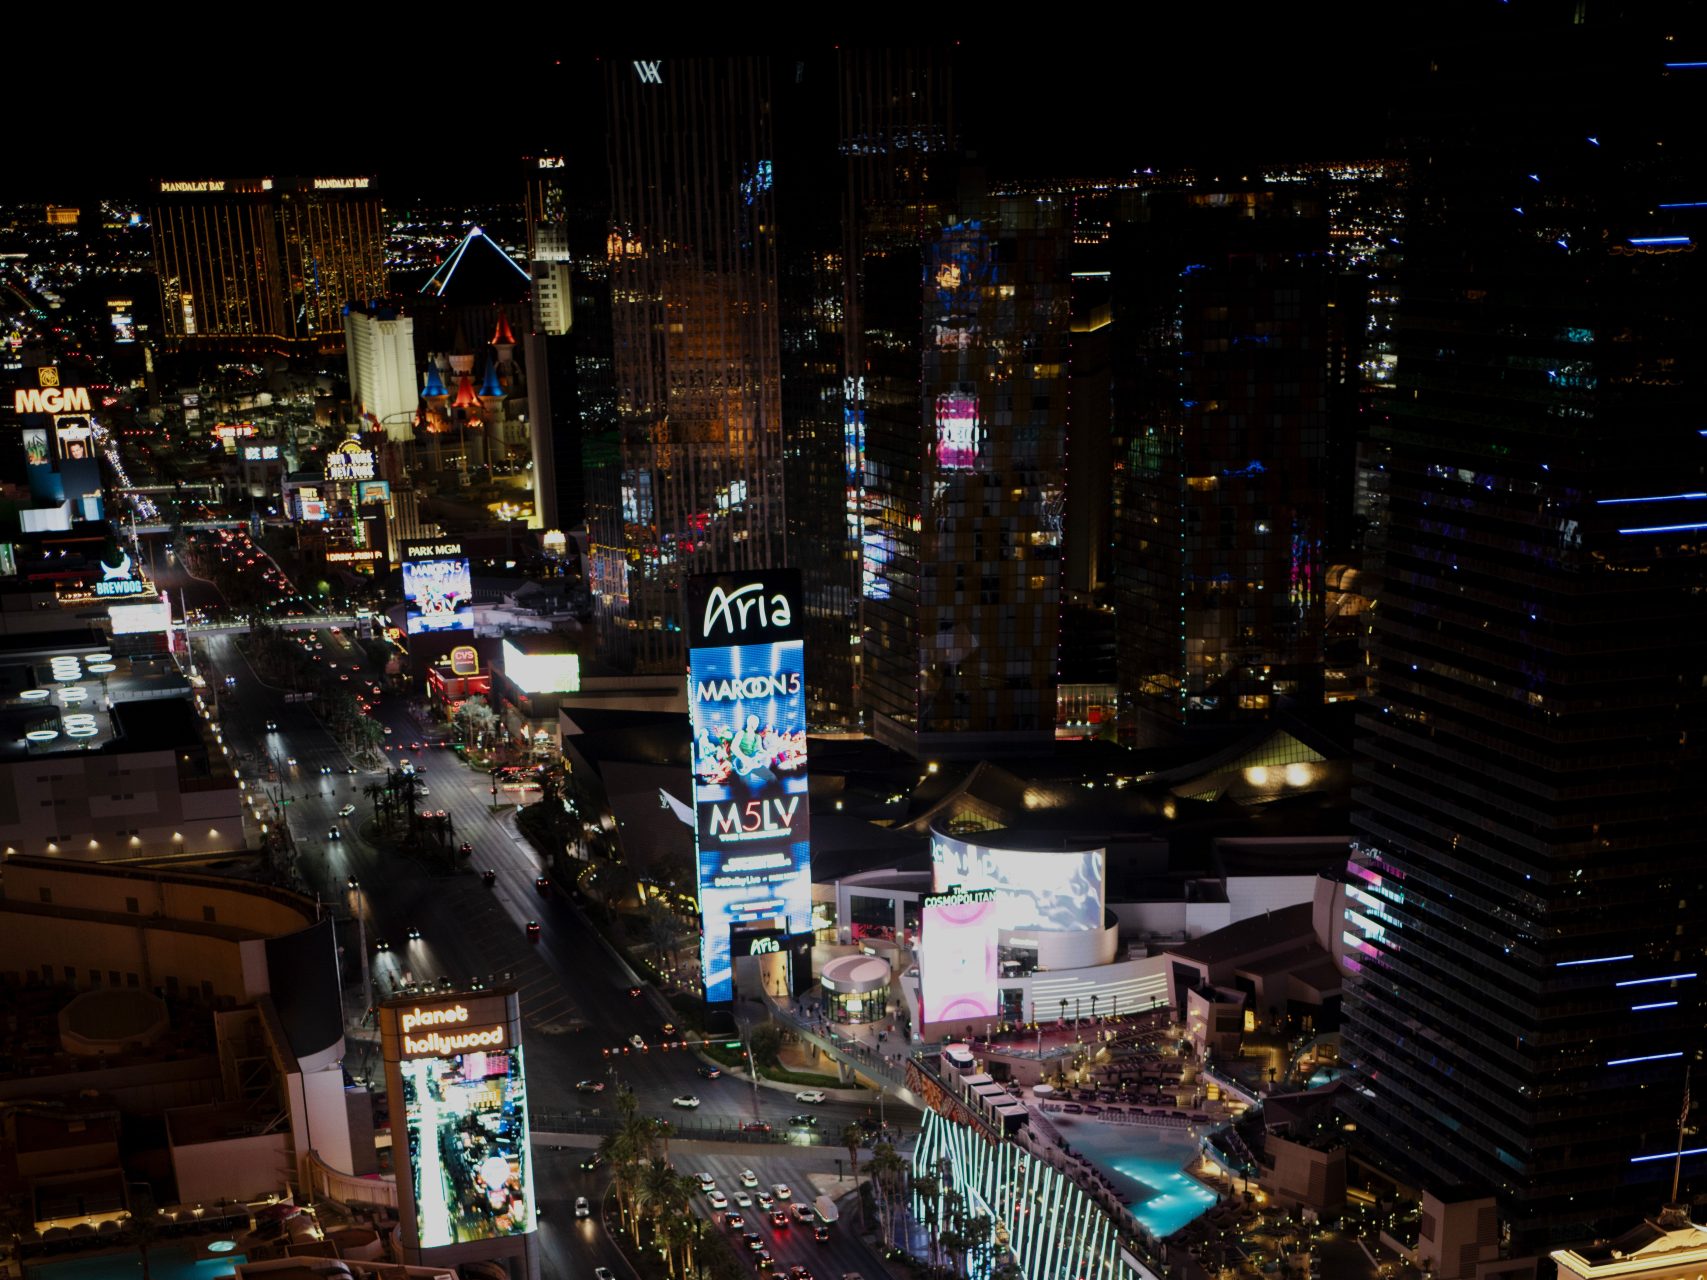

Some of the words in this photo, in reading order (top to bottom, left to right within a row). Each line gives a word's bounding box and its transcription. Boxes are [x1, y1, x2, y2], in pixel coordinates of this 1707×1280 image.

[161, 182, 207, 192] MANDALAY
[209, 181, 225, 191] BAY
[314, 178, 354, 189] MANDALAY
[355, 178, 369, 188] BAY
[15, 387, 91, 413] MGM
[408, 546, 434, 557] PARK
[435, 544, 461, 555] MGM
[96, 580, 142, 595] BREWDOG
[703, 583, 791, 637] Aria
[455, 650, 474, 660] CVS
[697, 674, 787, 702] MAROON
[788, 673, 801, 694] 5
[709, 796, 799, 836] M5LV
[924, 891, 997, 908] COSMOPOLITAN
[750, 938, 780, 955] Aria
[402, 1005, 468, 1033] planet
[404, 1026, 503, 1055] hollywood
